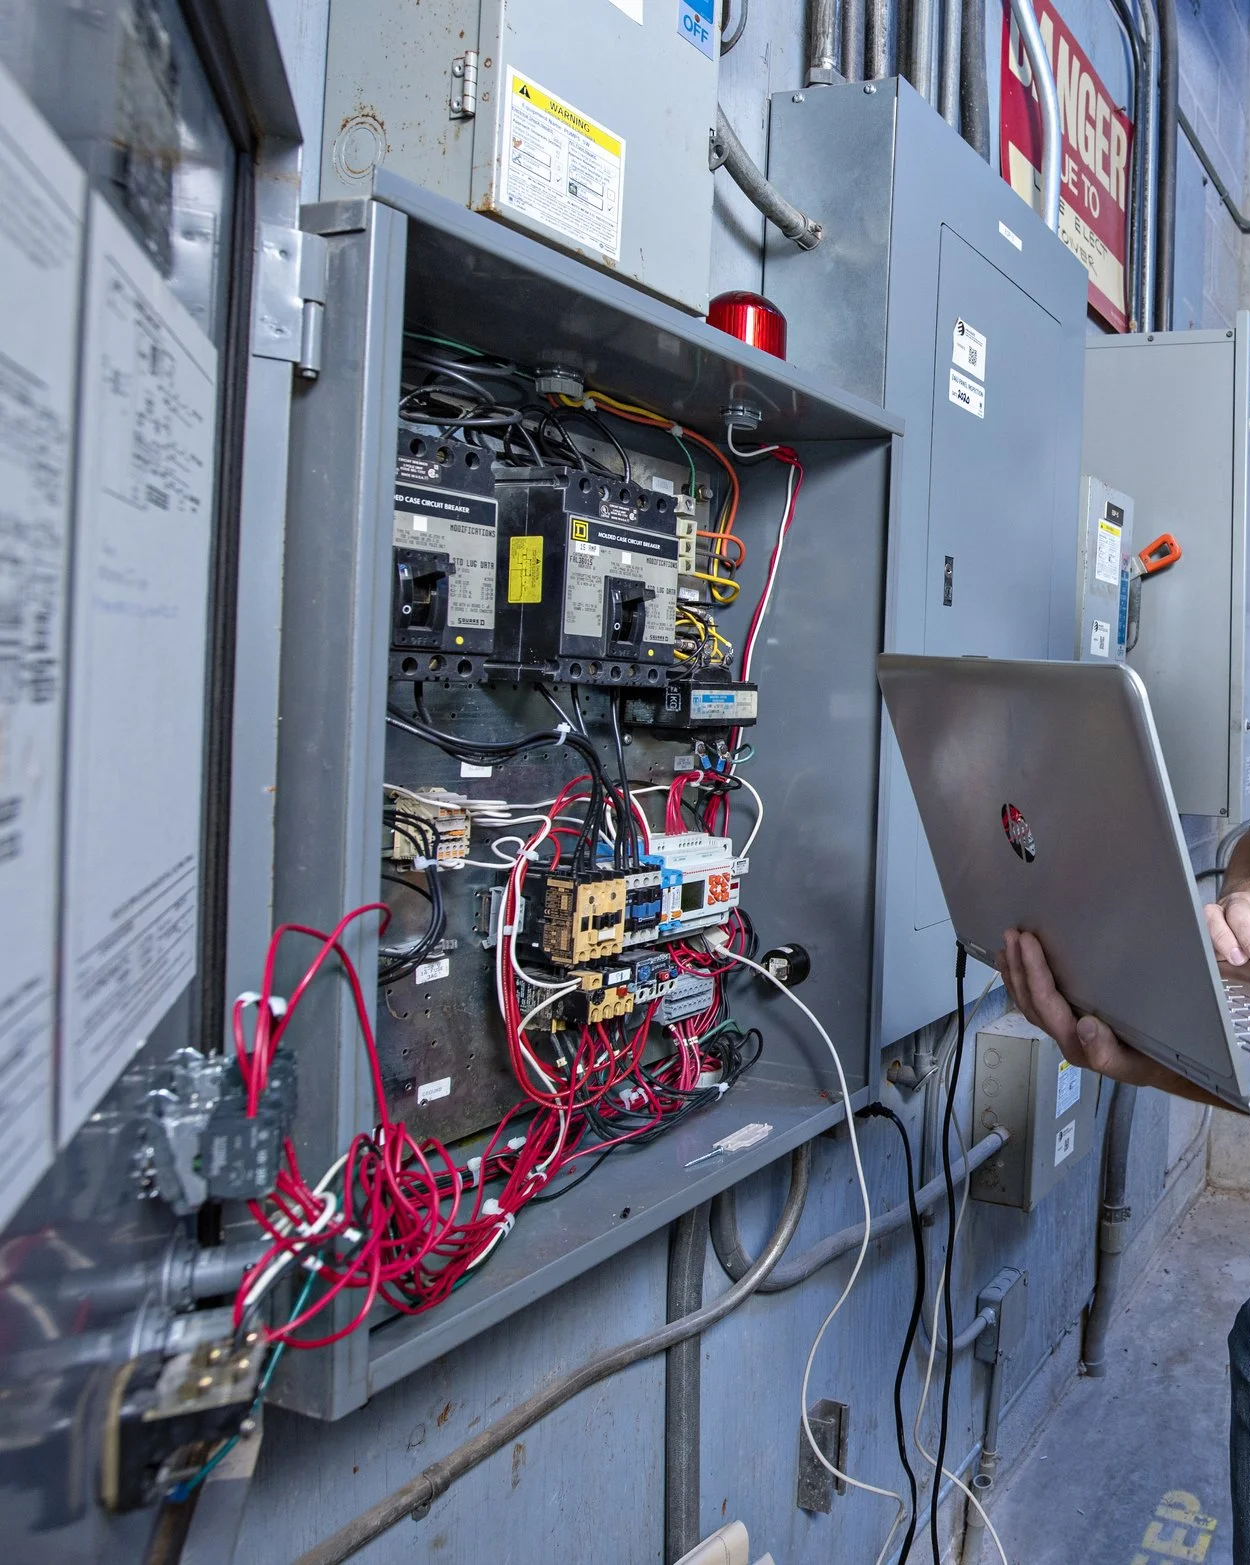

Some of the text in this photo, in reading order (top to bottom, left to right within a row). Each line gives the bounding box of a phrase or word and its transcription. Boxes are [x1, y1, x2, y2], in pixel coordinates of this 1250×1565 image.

[683, 14, 709, 43] OFF
[549, 101, 590, 133] WARNING
[1060, 153, 1100, 219] UE TO
[394, 494, 470, 514] ED CASE CIRCUIT BREAKER
[450, 524, 496, 538] MODIFICATIONS
[598, 532, 660, 550] MOLDED CASE CIRCUIT BREAKER
[452, 557, 495, 569] STD LUG DATA
